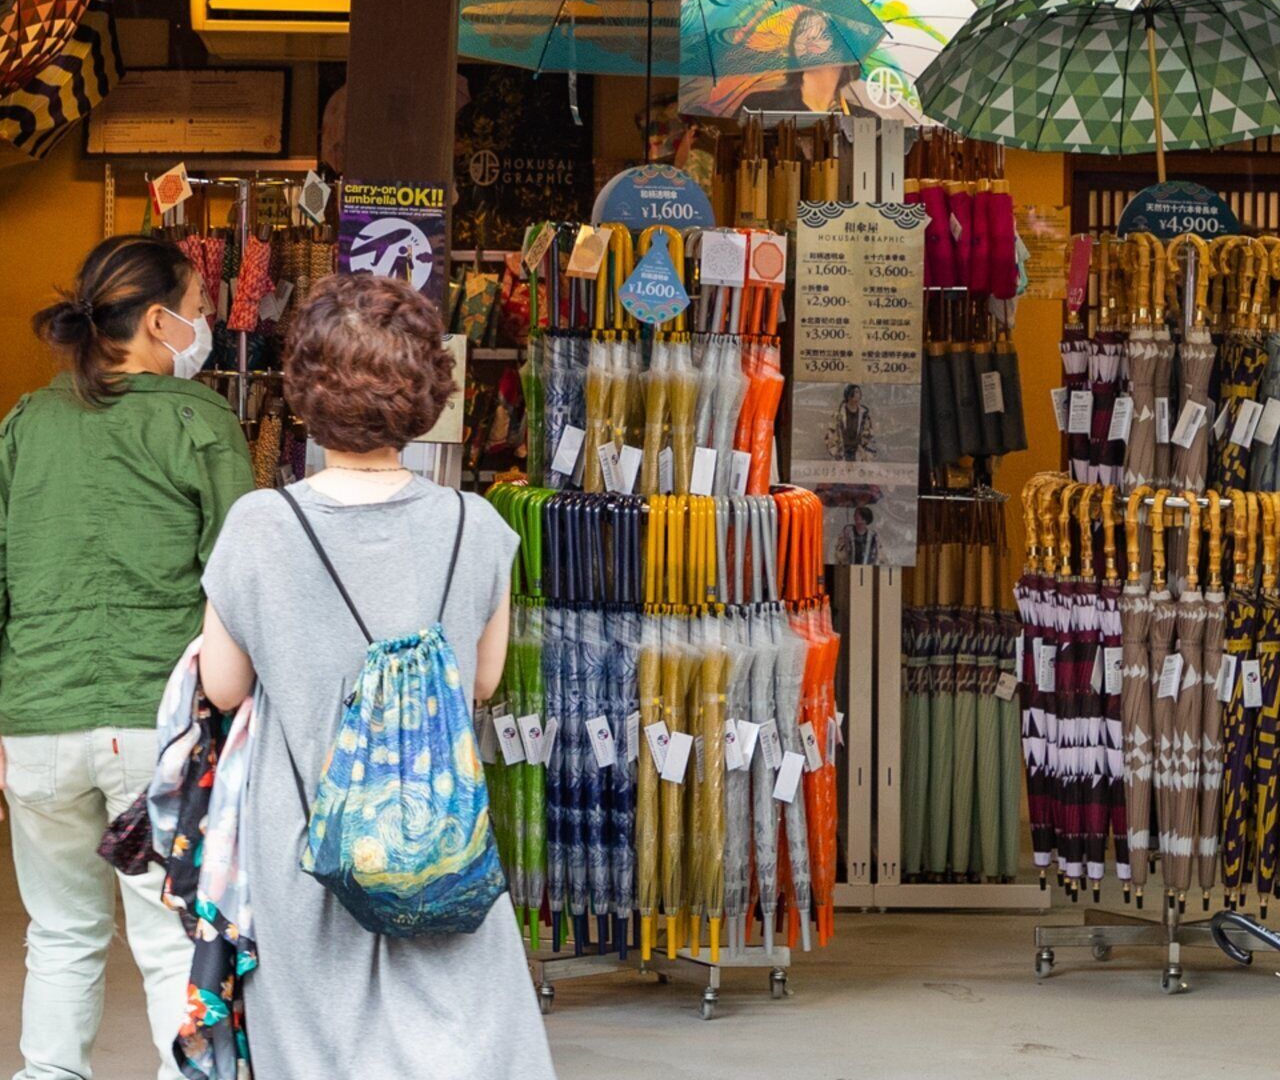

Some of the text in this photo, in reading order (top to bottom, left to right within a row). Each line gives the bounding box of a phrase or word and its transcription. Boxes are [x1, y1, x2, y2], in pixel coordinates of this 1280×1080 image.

[502, 158, 575, 170] HOKUSAI
[502, 172, 574, 185] GRAPHIC
[344, 184, 444, 207] carry-on OK!!
[344, 194, 397, 205] umbrella
[818, 234, 906, 243] HOKUSAI GRAPHIC
